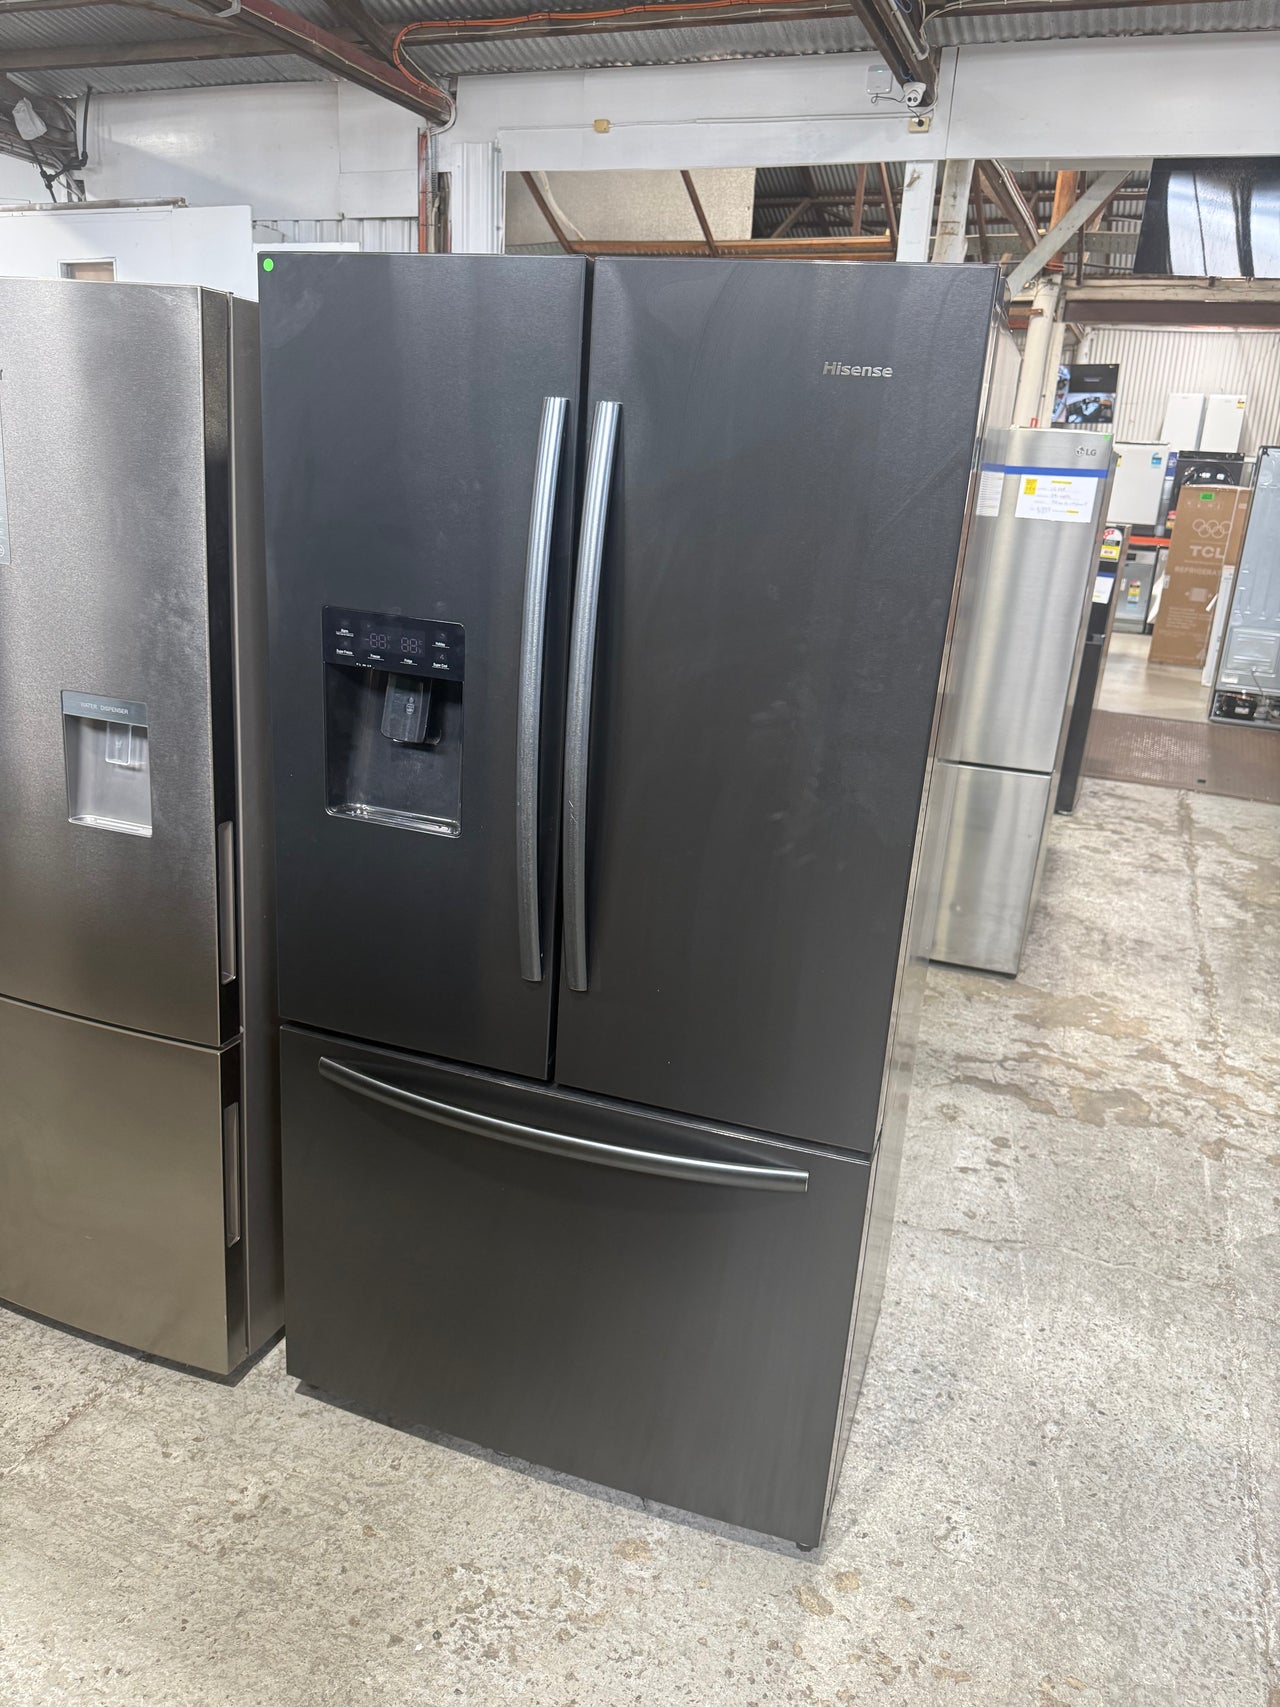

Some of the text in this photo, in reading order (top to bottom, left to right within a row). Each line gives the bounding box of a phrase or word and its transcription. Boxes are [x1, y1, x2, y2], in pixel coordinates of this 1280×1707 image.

[823, 361, 893, 377] Hisense
[1086, 448, 1097, 456] LG
[1189, 545, 1224, 559] TCL
